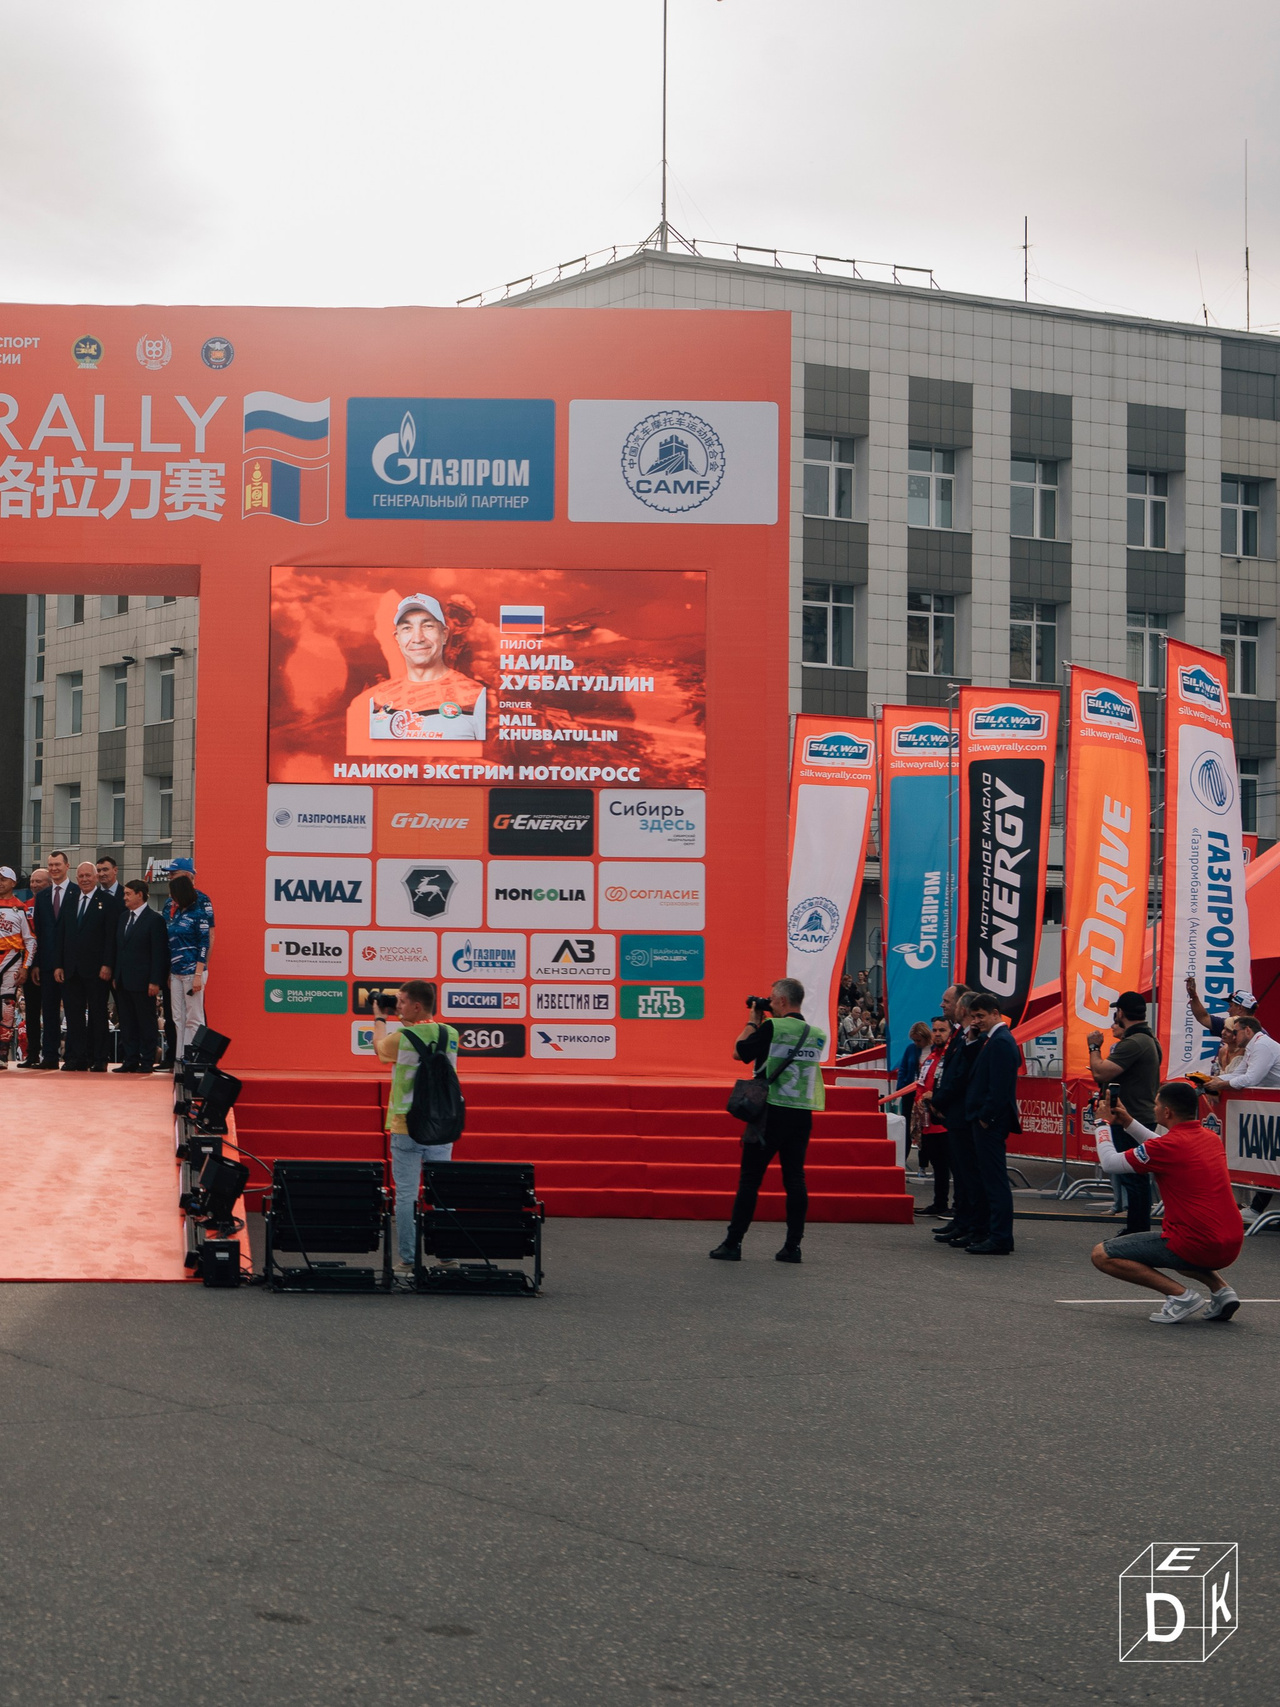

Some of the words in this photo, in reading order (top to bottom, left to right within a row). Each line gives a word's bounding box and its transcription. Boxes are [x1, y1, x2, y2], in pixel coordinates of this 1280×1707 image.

[420, 458, 530, 487] ГАЗПРОМ
[636, 480, 710, 494] CAMF
[373, 492, 468, 508] ГЕНЕРАЛЬНЫЙ
[472, 494, 530, 509] ПАРТНЕР
[500, 639, 543, 650] ПИЛОТ
[500, 654, 574, 670] НАИЛЬ
[499, 674, 655, 693] ХУББАТУЛЛИН
[1182, 675, 1205, 692] SILK
[1203, 682, 1221, 696] WAY
[500, 701, 532, 709] DRIVER
[1088, 699, 1112, 710] SILK
[1112, 703, 1132, 715] WAY
[1100, 708, 1125, 717] RALLY
[499, 714, 536, 727] NAIL
[975, 715, 1008, 724] SILK
[1010, 715, 1041, 725] WAY
[499, 728, 618, 742] KHUBBATULLIN
[898, 733, 925, 742] SILK
[1080, 727, 1143, 746] silkwayrally.com
[809, 743, 836, 752] SILK
[837, 744, 867, 754] WAY
[968, 743, 1047, 753] silkwayrally.com
[333, 763, 418, 779] НАИКОМ
[423, 764, 514, 780] ЭКСТРИМ
[519, 765, 640, 782] МОТОКРОСС
[800, 769, 871, 781] silkwayrally.com
[982, 772, 992, 834] МАСЛО
[609, 801, 684, 820] Сибирь
[297, 813, 367, 824] ГАЗПРОМБАНК
[639, 818, 695, 833] здесь
[274, 878, 363, 903] KAMAZ
[495, 888, 586, 901] MONGOLIA
[629, 889, 700, 899] СОГЛАСИЕ
[980, 838, 992, 939] МОТОРНОЕ
[920, 871, 941, 939] ГАЗПРОМ
[789, 933, 830, 944] CAMF
[1199, 830, 1235, 1061] ГАЗПРОМБАК
[285, 941, 343, 957] Delko
[380, 946, 422, 954] РУССКАЯ
[473, 948, 516, 960] ГАЗПРОМ
[1185, 917, 1201, 980] (Акционер
[380, 954, 428, 963] МЕХАНИКА
[536, 967, 611, 976] ЛЕНЗОЛОТО
[305, 990, 343, 998] НОВОСТИ
[452, 995, 498, 1006] РОССИЯ
[504, 996, 519, 1005] 24
[536, 993, 590, 1010] ИЗВЕСТИЯ
[638, 987, 685, 1018] НТВ
[463, 1030, 504, 1048] 360
[557, 1035, 611, 1043] ТРИКОЛОР
[787, 1048, 815, 1058] POTO
[778, 1064, 817, 1100] 21
[1023, 1100, 1041, 1116] 2025
